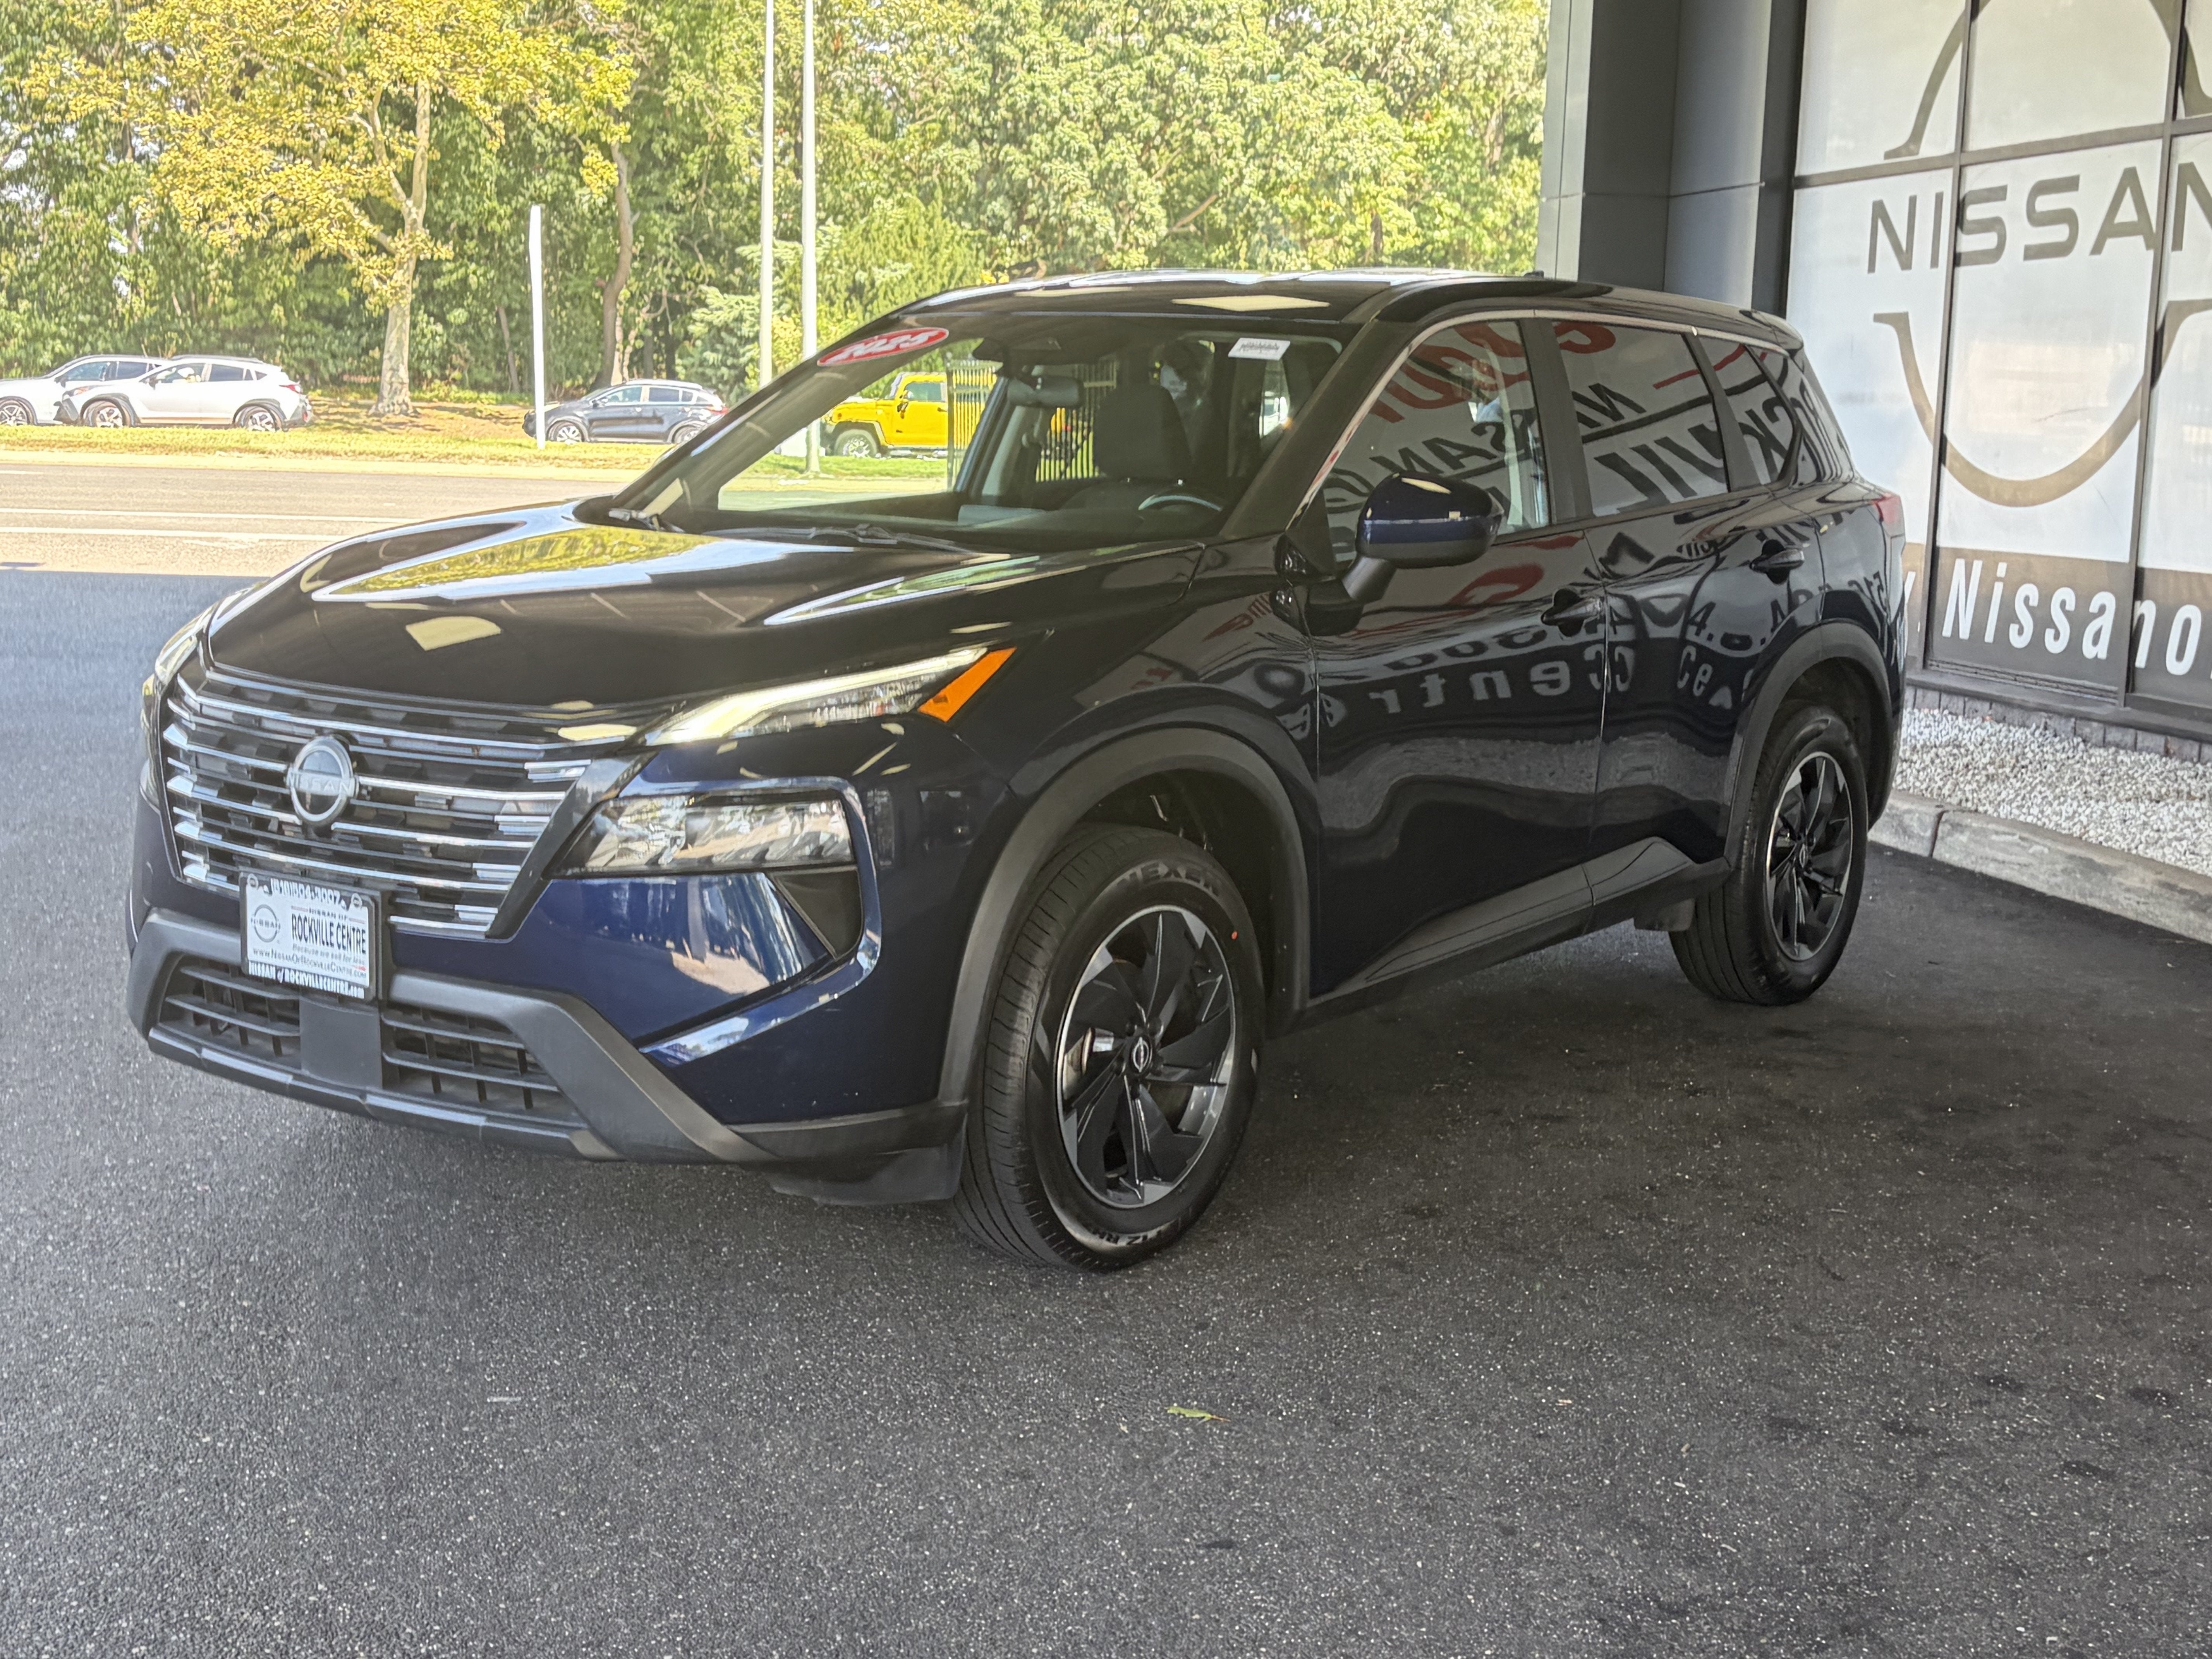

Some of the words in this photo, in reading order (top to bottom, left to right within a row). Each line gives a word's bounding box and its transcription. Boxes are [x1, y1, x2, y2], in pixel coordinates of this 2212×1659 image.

[287, 766, 356, 798] NISSAN
[291, 913, 334, 947] ROCKVILLE
[336, 922, 366, 954] CENTRE
